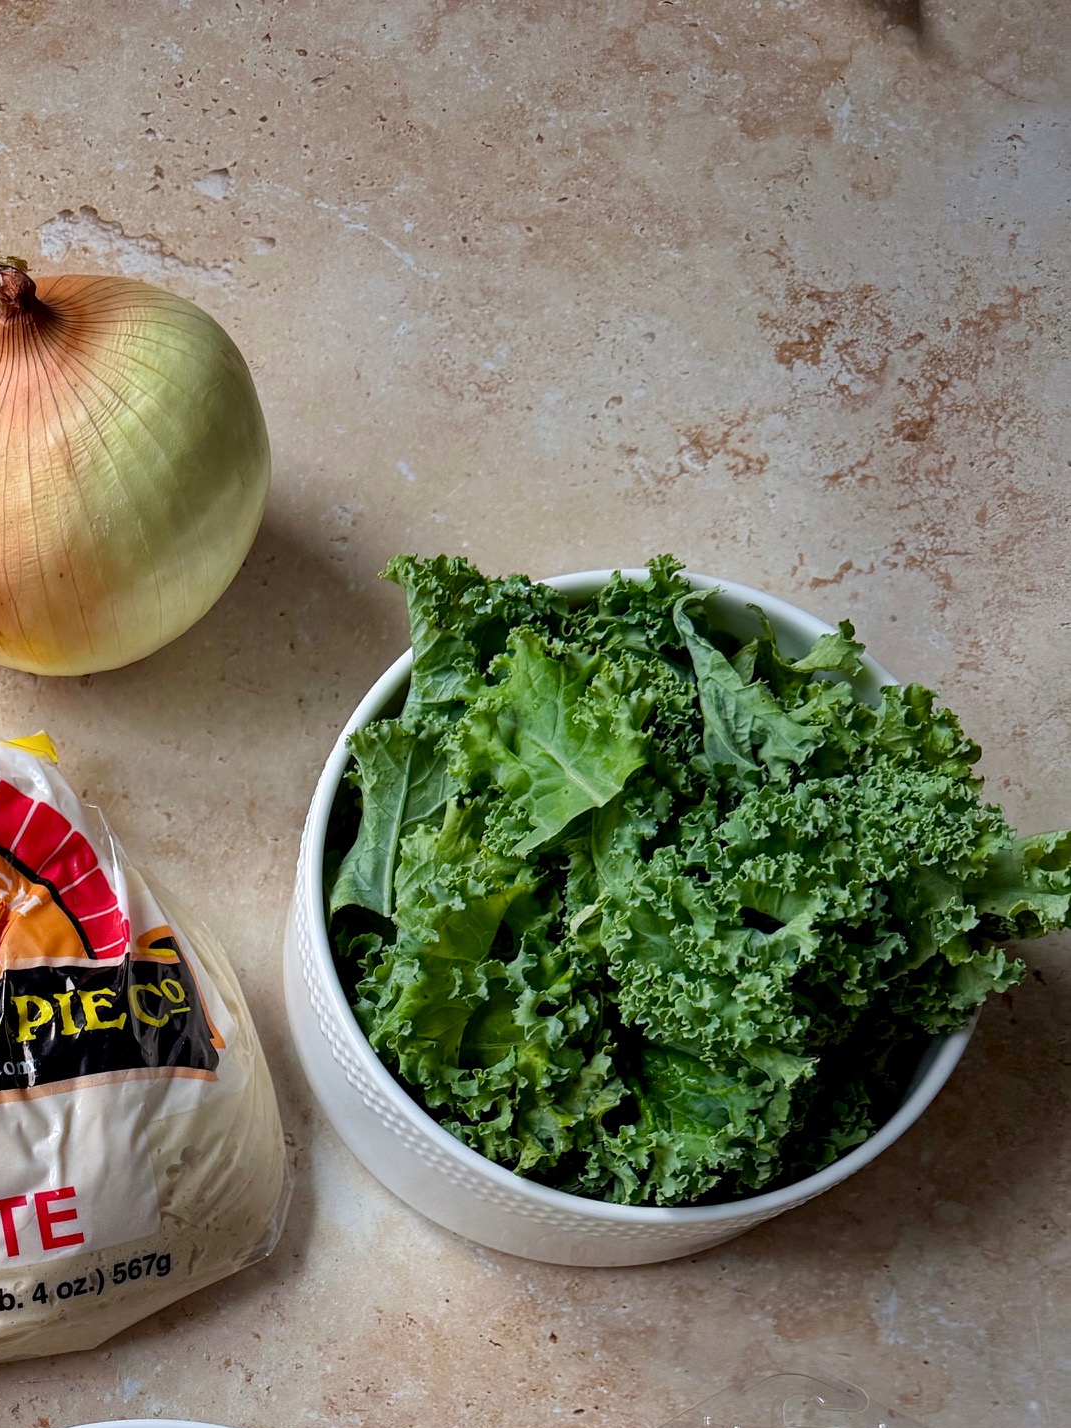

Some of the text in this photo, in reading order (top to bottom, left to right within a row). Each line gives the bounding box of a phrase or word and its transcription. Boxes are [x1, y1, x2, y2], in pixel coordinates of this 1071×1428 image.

[11, 987, 127, 1043] PIE
[32, 1282, 48, 1305] 4
[56, 1269, 105, 1301] oz.)
[112, 1253, 172, 1285] 567g
